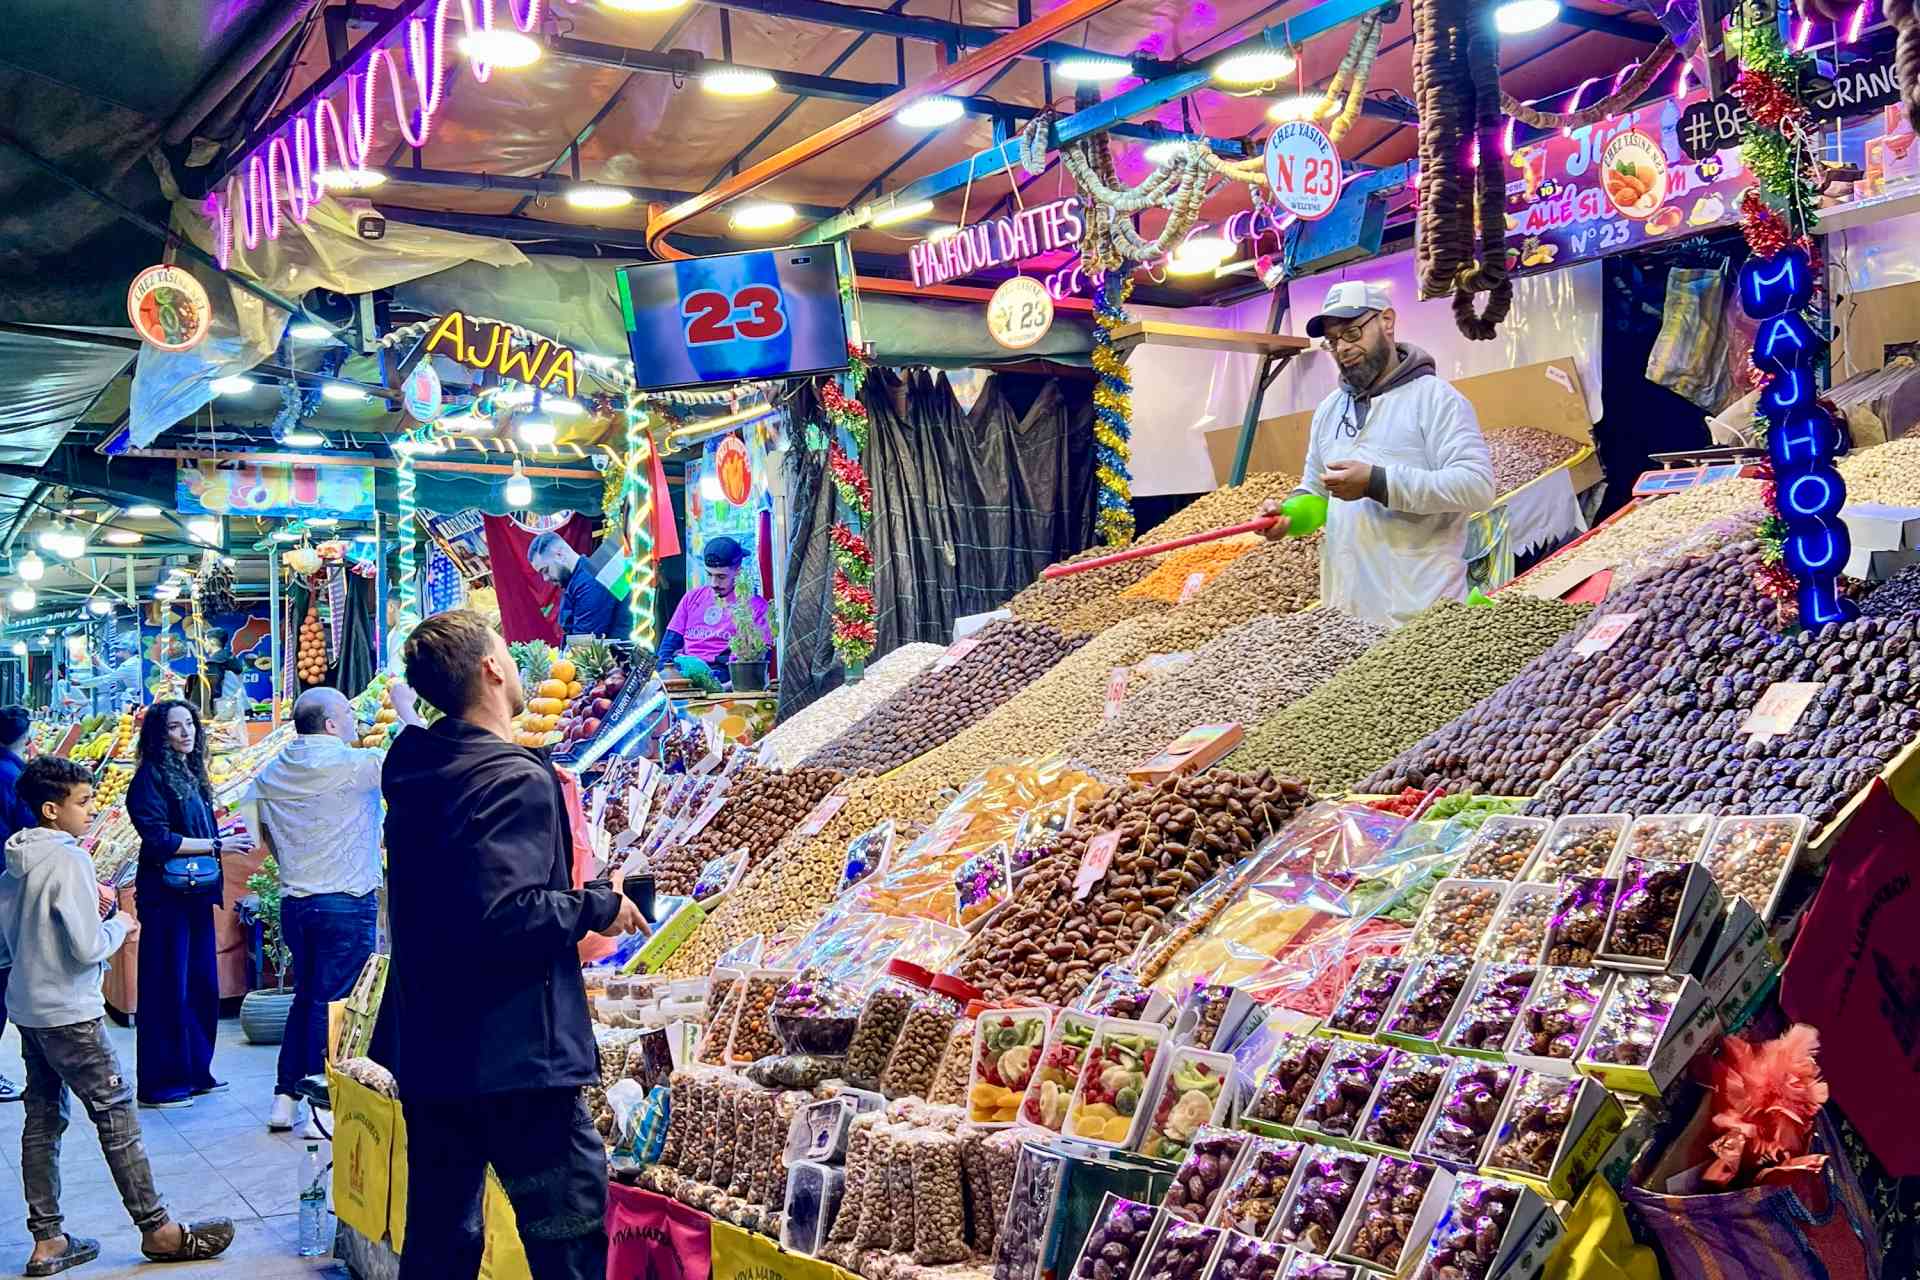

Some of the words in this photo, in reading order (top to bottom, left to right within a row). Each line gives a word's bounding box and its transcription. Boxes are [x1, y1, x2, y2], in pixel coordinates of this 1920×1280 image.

[1272, 123, 1297, 149] CHEZ
[1299, 123, 1329, 154] YASINE
[1604, 137, 1623, 168] CHEZ
[1304, 158, 1334, 197] 23
[911, 226, 1000, 289] MAJHOUL
[1000, 197, 1083, 261] DATTES
[1599, 220, 1632, 249] 23
[683, 285, 785, 345] 23
[1020, 301, 1046, 330] 23
[426, 311, 575, 400] AJWA
[1752, 257, 1843, 623] MAJHOUL
